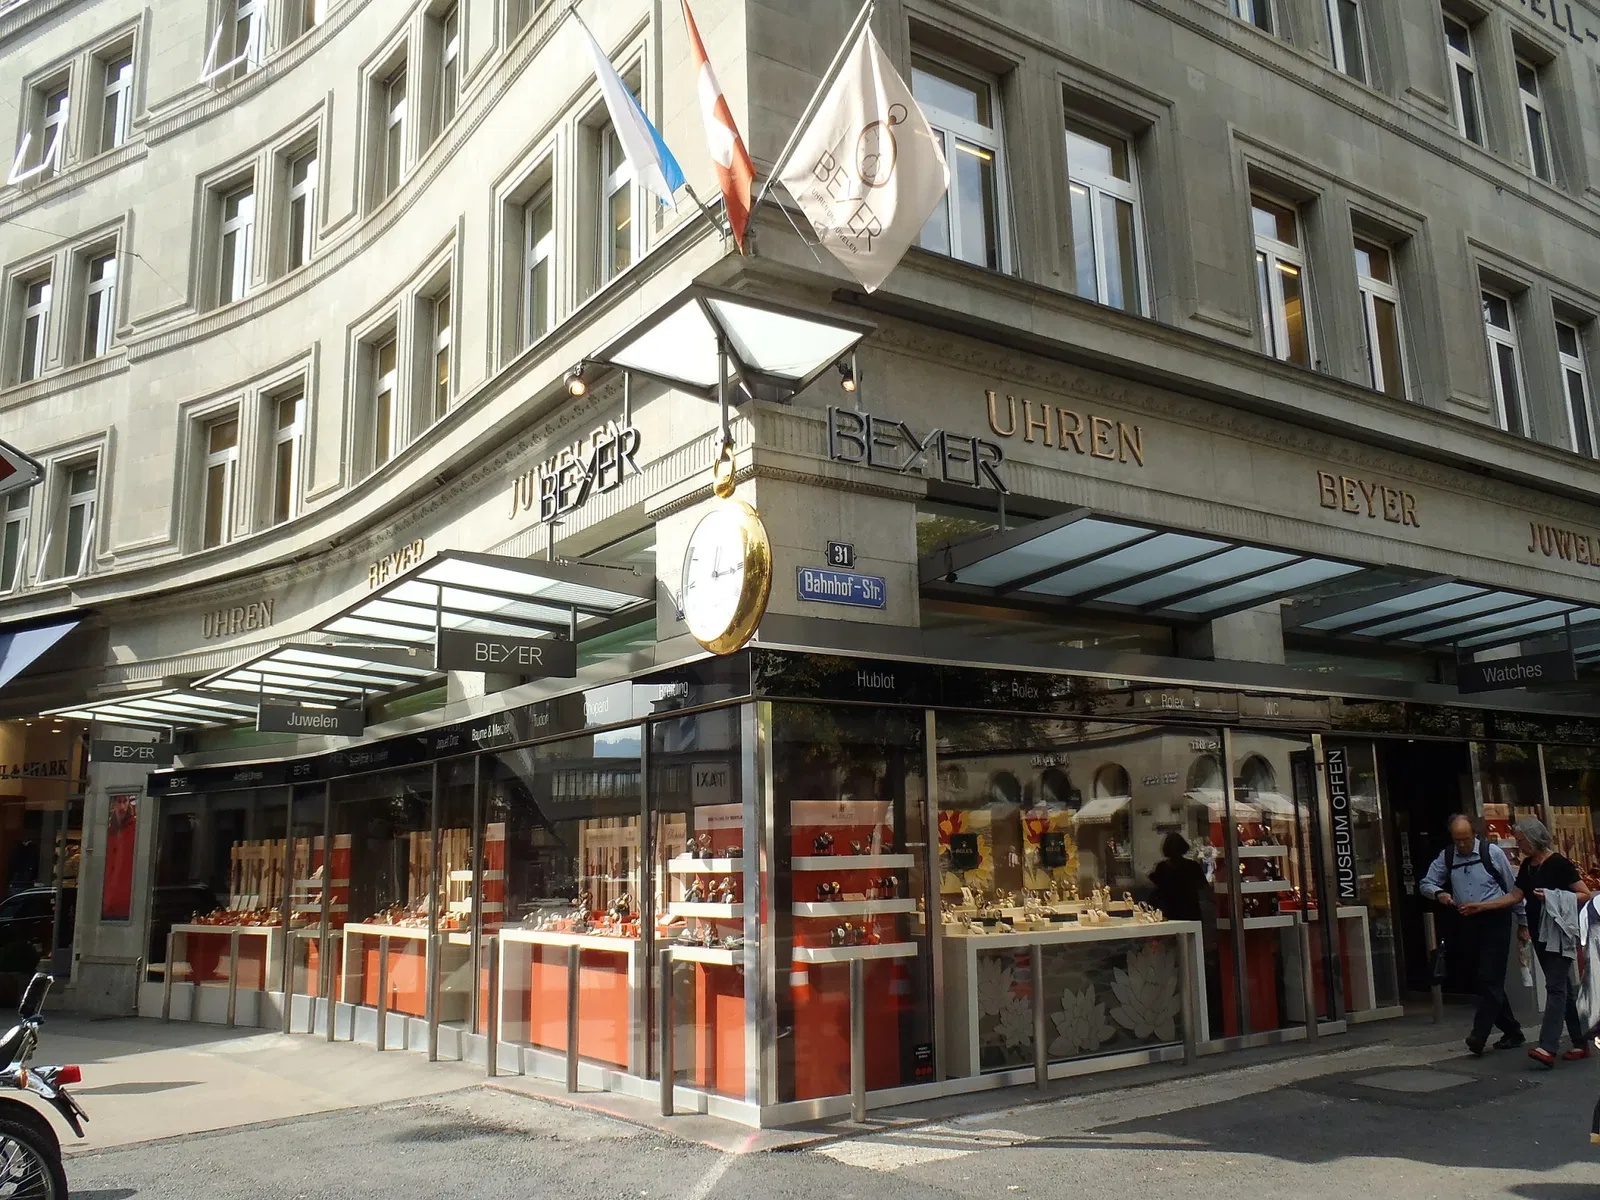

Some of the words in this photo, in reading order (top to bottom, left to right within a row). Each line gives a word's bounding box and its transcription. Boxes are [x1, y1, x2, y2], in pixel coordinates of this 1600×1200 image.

[812, 149, 882, 252] BEYER
[985, 389, 1144, 467] UHREN
[826, 404, 1010, 495] BEYER
[541, 426, 643, 522] BEYER
[1317, 470, 1420, 528] BEYER
[834, 545, 849, 564] 31
[201, 598, 275, 639] UHREN
[475, 642, 543, 666] BEYER
[857, 671, 895, 689] Hublot
[1482, 663, 1543, 683] Watches
[659, 680, 689, 699] Breitling
[1011, 682, 1039, 698] Rolex
[1161, 694, 1185, 709] Rolex
[287, 712, 339, 728] Juwelen
[488, 726, 493, 738] &
[113, 745, 155, 759] BEYER
[1328, 750, 1347, 810] OFFEN
[1335, 815, 1355, 898] MUSEUM
